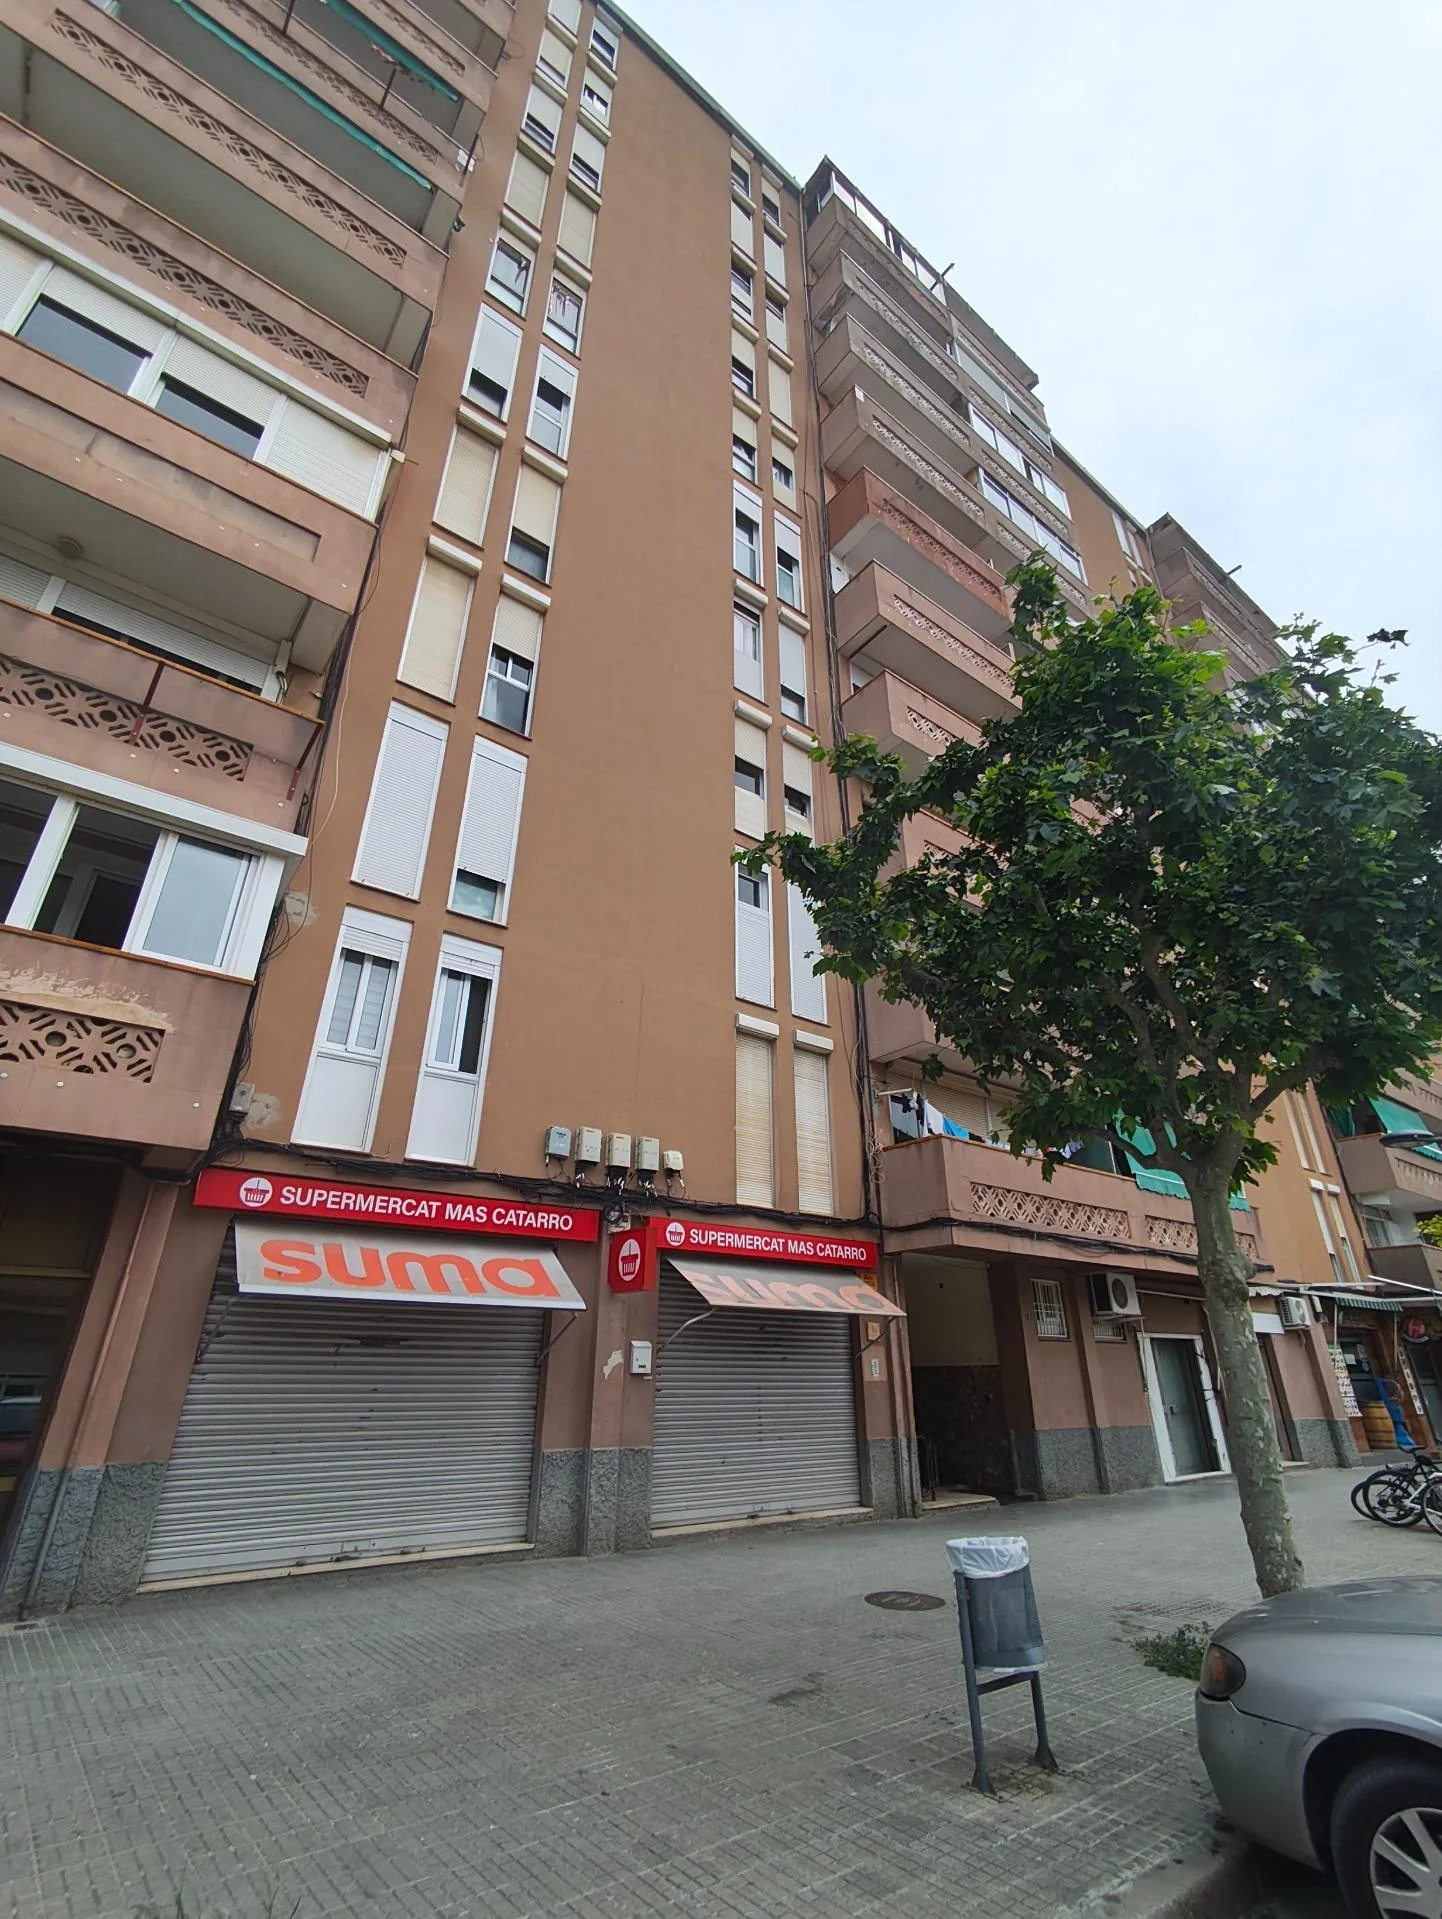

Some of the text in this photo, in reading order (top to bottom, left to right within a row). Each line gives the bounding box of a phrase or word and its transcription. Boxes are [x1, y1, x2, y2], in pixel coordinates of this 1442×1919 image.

[280, 1186, 573, 1231] SUPERMERCAT MAS CATARRO
[689, 1228, 867, 1261] SUPERMERCAT MAS CATARRO
[259, 1239, 561, 1297] suma
[680, 1270, 899, 1314] suma
